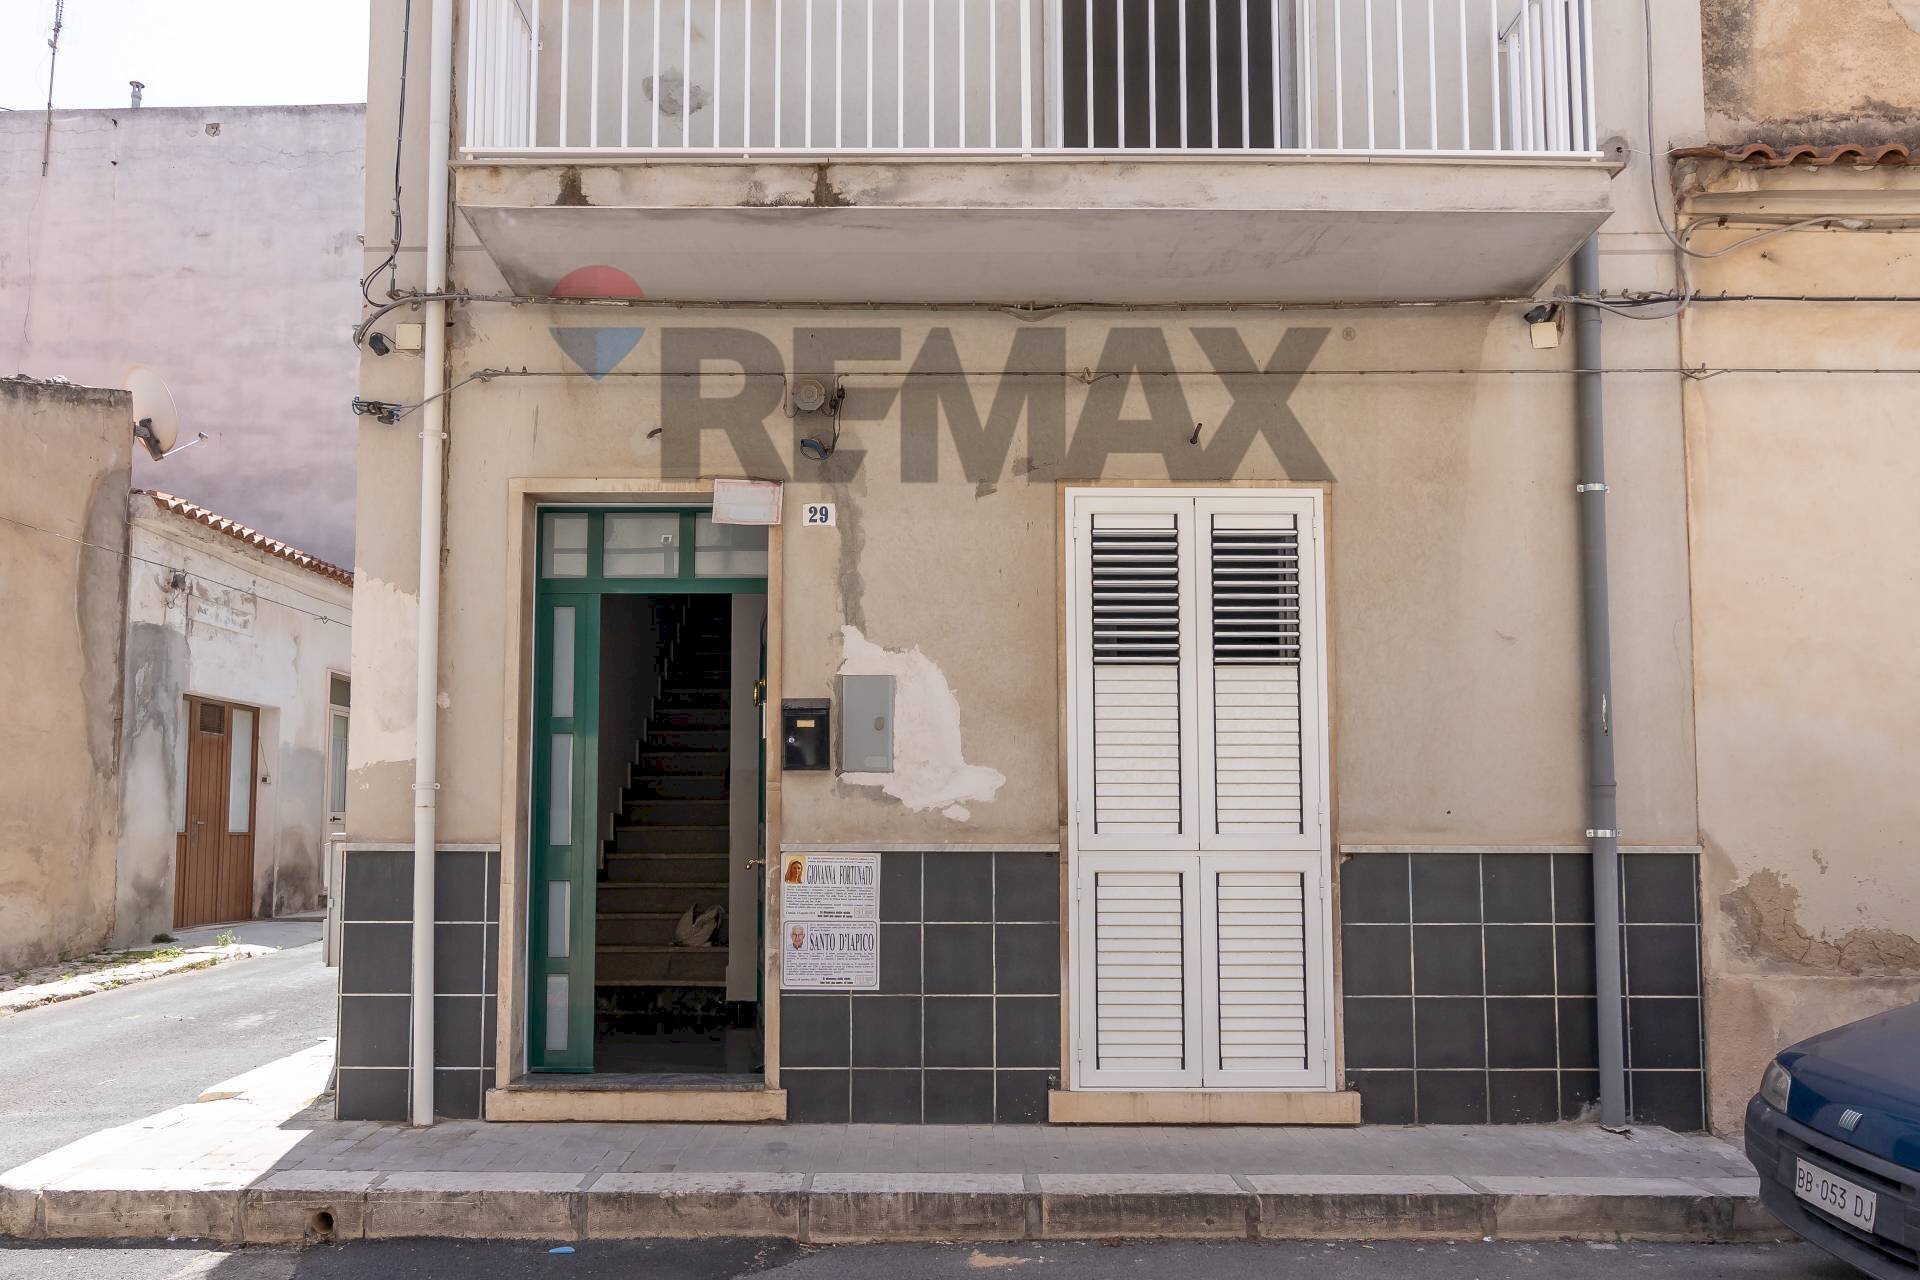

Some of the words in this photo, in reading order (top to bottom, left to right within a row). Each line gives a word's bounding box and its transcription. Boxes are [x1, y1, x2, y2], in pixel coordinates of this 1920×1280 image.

[808, 506, 829, 523] 29
[807, 864, 836, 884] GIOVANNA
[840, 865, 873, 885] FORTUNATO
[809, 933, 835, 951] SANTO
[1798, 1168, 1813, 1192] BB
[1821, 1180, 1847, 1209] 053
